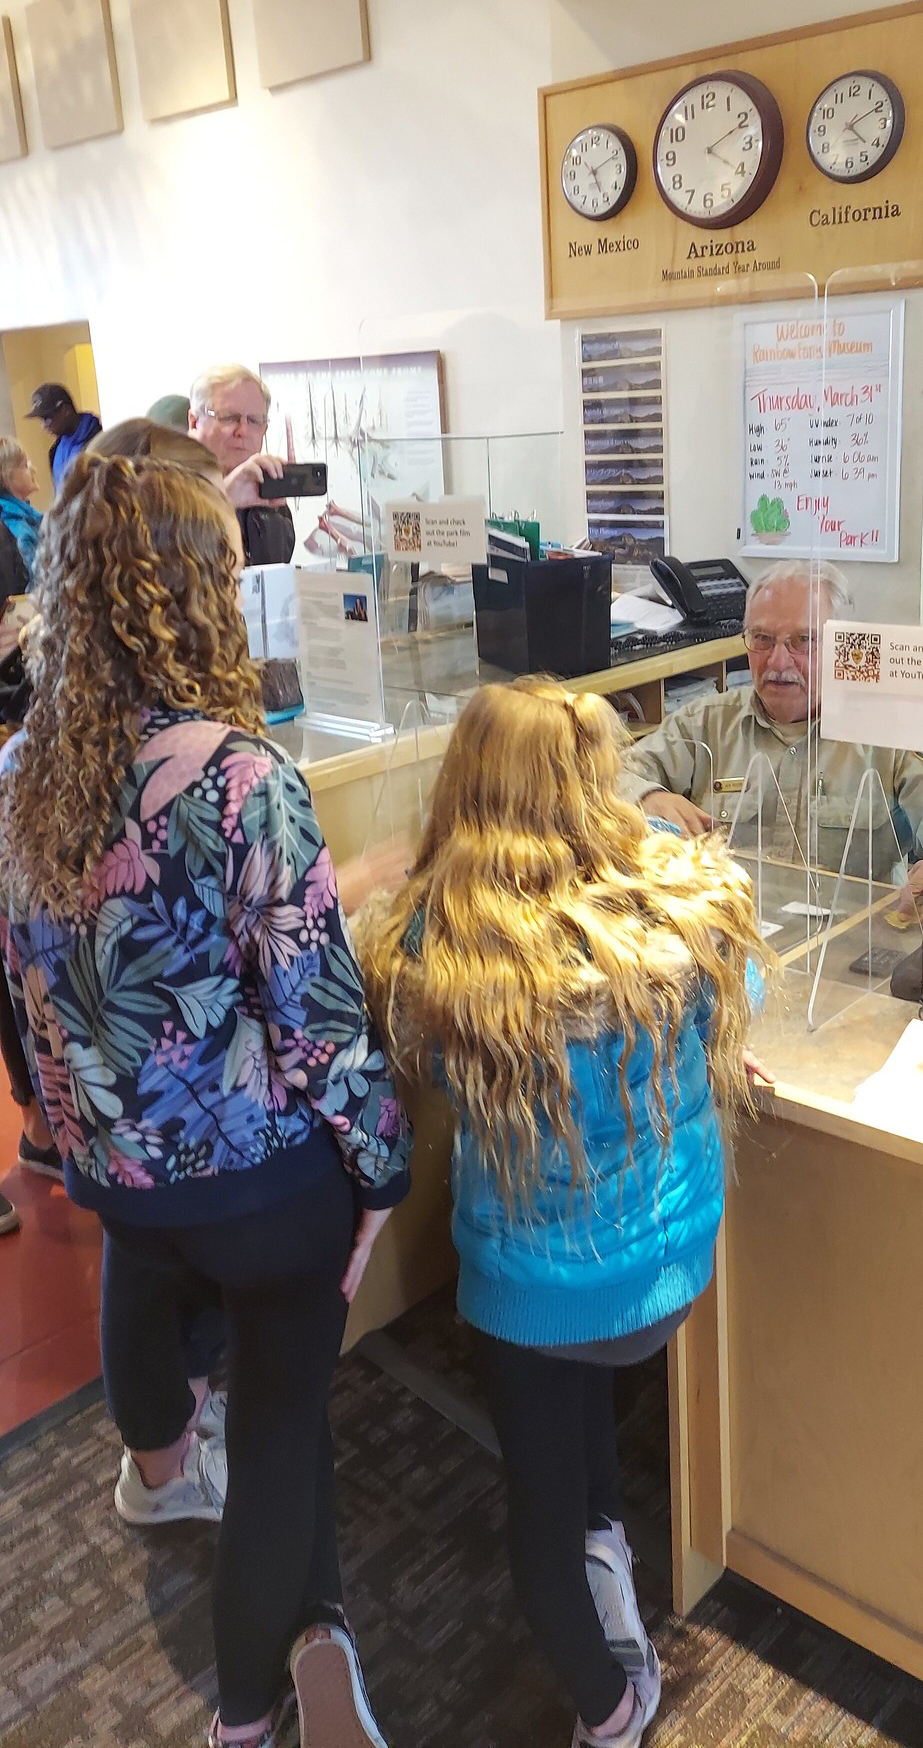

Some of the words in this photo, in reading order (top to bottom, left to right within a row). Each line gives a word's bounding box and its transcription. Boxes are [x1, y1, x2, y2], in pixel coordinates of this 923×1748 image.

[848, 85, 860, 97] 12
[701, 92, 716, 110] 12
[835, 92, 843, 104] 11
[684, 104, 695, 120] 11
[822, 107, 835, 120] 10
[874, 101, 884, 113] 2
[737, 111, 749, 129] 2
[878, 117, 887, 130] 3
[669, 126, 685, 143] 10
[817, 125, 826, 137] 9
[581, 142, 587, 152] 11
[591, 136, 600, 147] 12
[742, 135, 753, 151] 3
[821, 142, 830, 154] 8
[871, 137, 880, 148] 4
[572, 155, 581, 166] 10
[612, 149, 618, 159] 2
[665, 150, 676, 167] 9
[860, 150, 868, 163] 5
[615, 164, 621, 174] 3
[734, 162, 746, 177] 4
[845, 157, 854, 169] 6
[569, 169, 576, 181] 9
[672, 173, 683, 190] 8
[573, 185, 580, 195] 8
[720, 182, 732, 199] 5
[582, 195, 587, 205] 7
[592, 198, 598, 208] 6
[603, 192, 609, 202] 5
[685, 189, 696, 205] 7
[703, 192, 714, 209] 6
[809, 199, 902, 228] California
[568, 241, 593, 258] New
[597, 234, 640, 254] Mexico
[686, 237, 756, 260] Arizona
[661, 266, 695, 282] Mountain
[697, 261, 730, 278] Standard
[732, 259, 750, 274] Year
[752, 256, 781, 271] Around
[832, 318, 845, 337] to
[828, 339, 873, 357] Museum
[824, 385, 858, 407] March
[846, 413, 856, 427] 7
[864, 412, 874, 425] 10
[850, 431, 869, 447] 36%
[776, 454, 789, 467] 5%
[796, 494, 829, 516] Enjoy
[450, 518, 465, 526] check
[818, 514, 846, 534] Your
[446, 529, 458, 538] park
[459, 529, 471, 537] film
[889, 642, 910, 652] Scan
[889, 657, 904, 665] out
[907, 656, 922, 666] the
[889, 670, 897, 678] at
